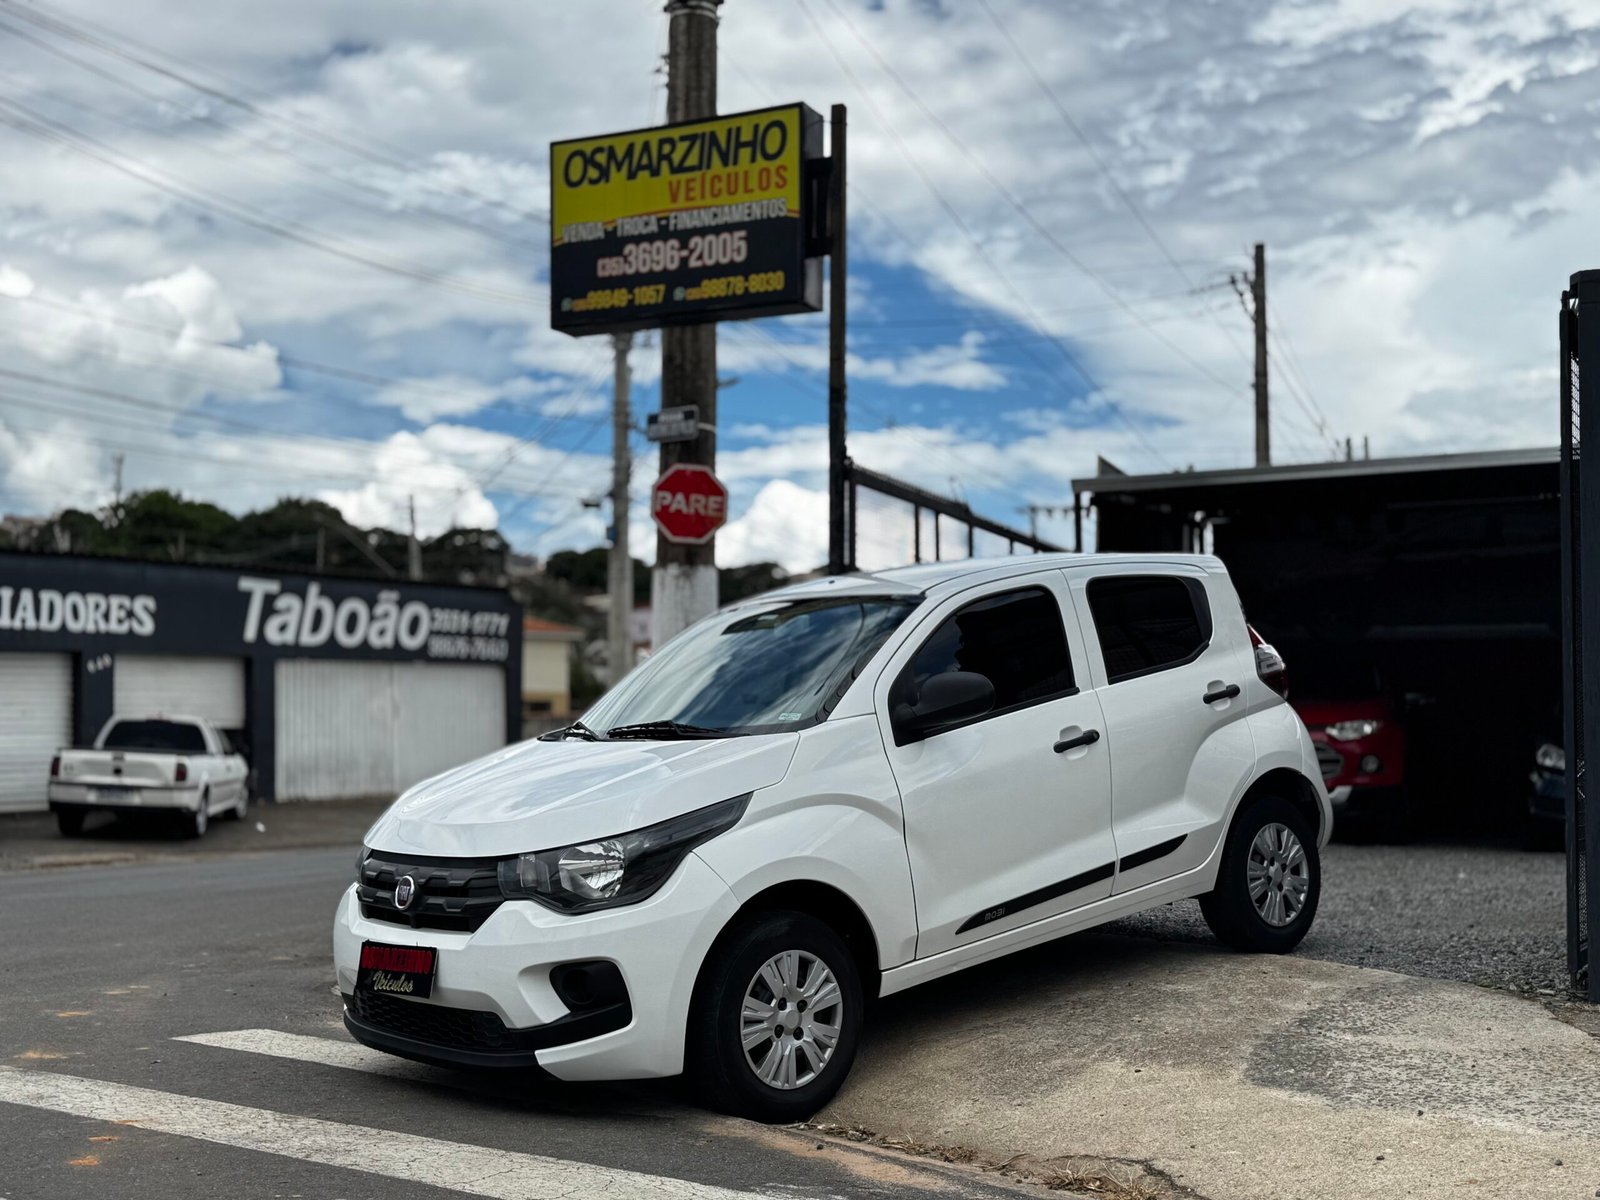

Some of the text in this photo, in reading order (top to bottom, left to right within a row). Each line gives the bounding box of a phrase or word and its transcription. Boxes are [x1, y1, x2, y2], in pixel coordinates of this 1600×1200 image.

[563, 120, 788, 188] OSMARZINHO
[668, 164, 789, 204] VEÍCULOS
[562, 221, 605, 242] VENDA
[616, 215, 659, 237] TROCA
[668, 198, 787, 231] FINANCIAMENTOS
[656, 490, 724, 518] PARE
[0, 586, 157, 636] IADORES
[238, 575, 431, 651] Taboão
